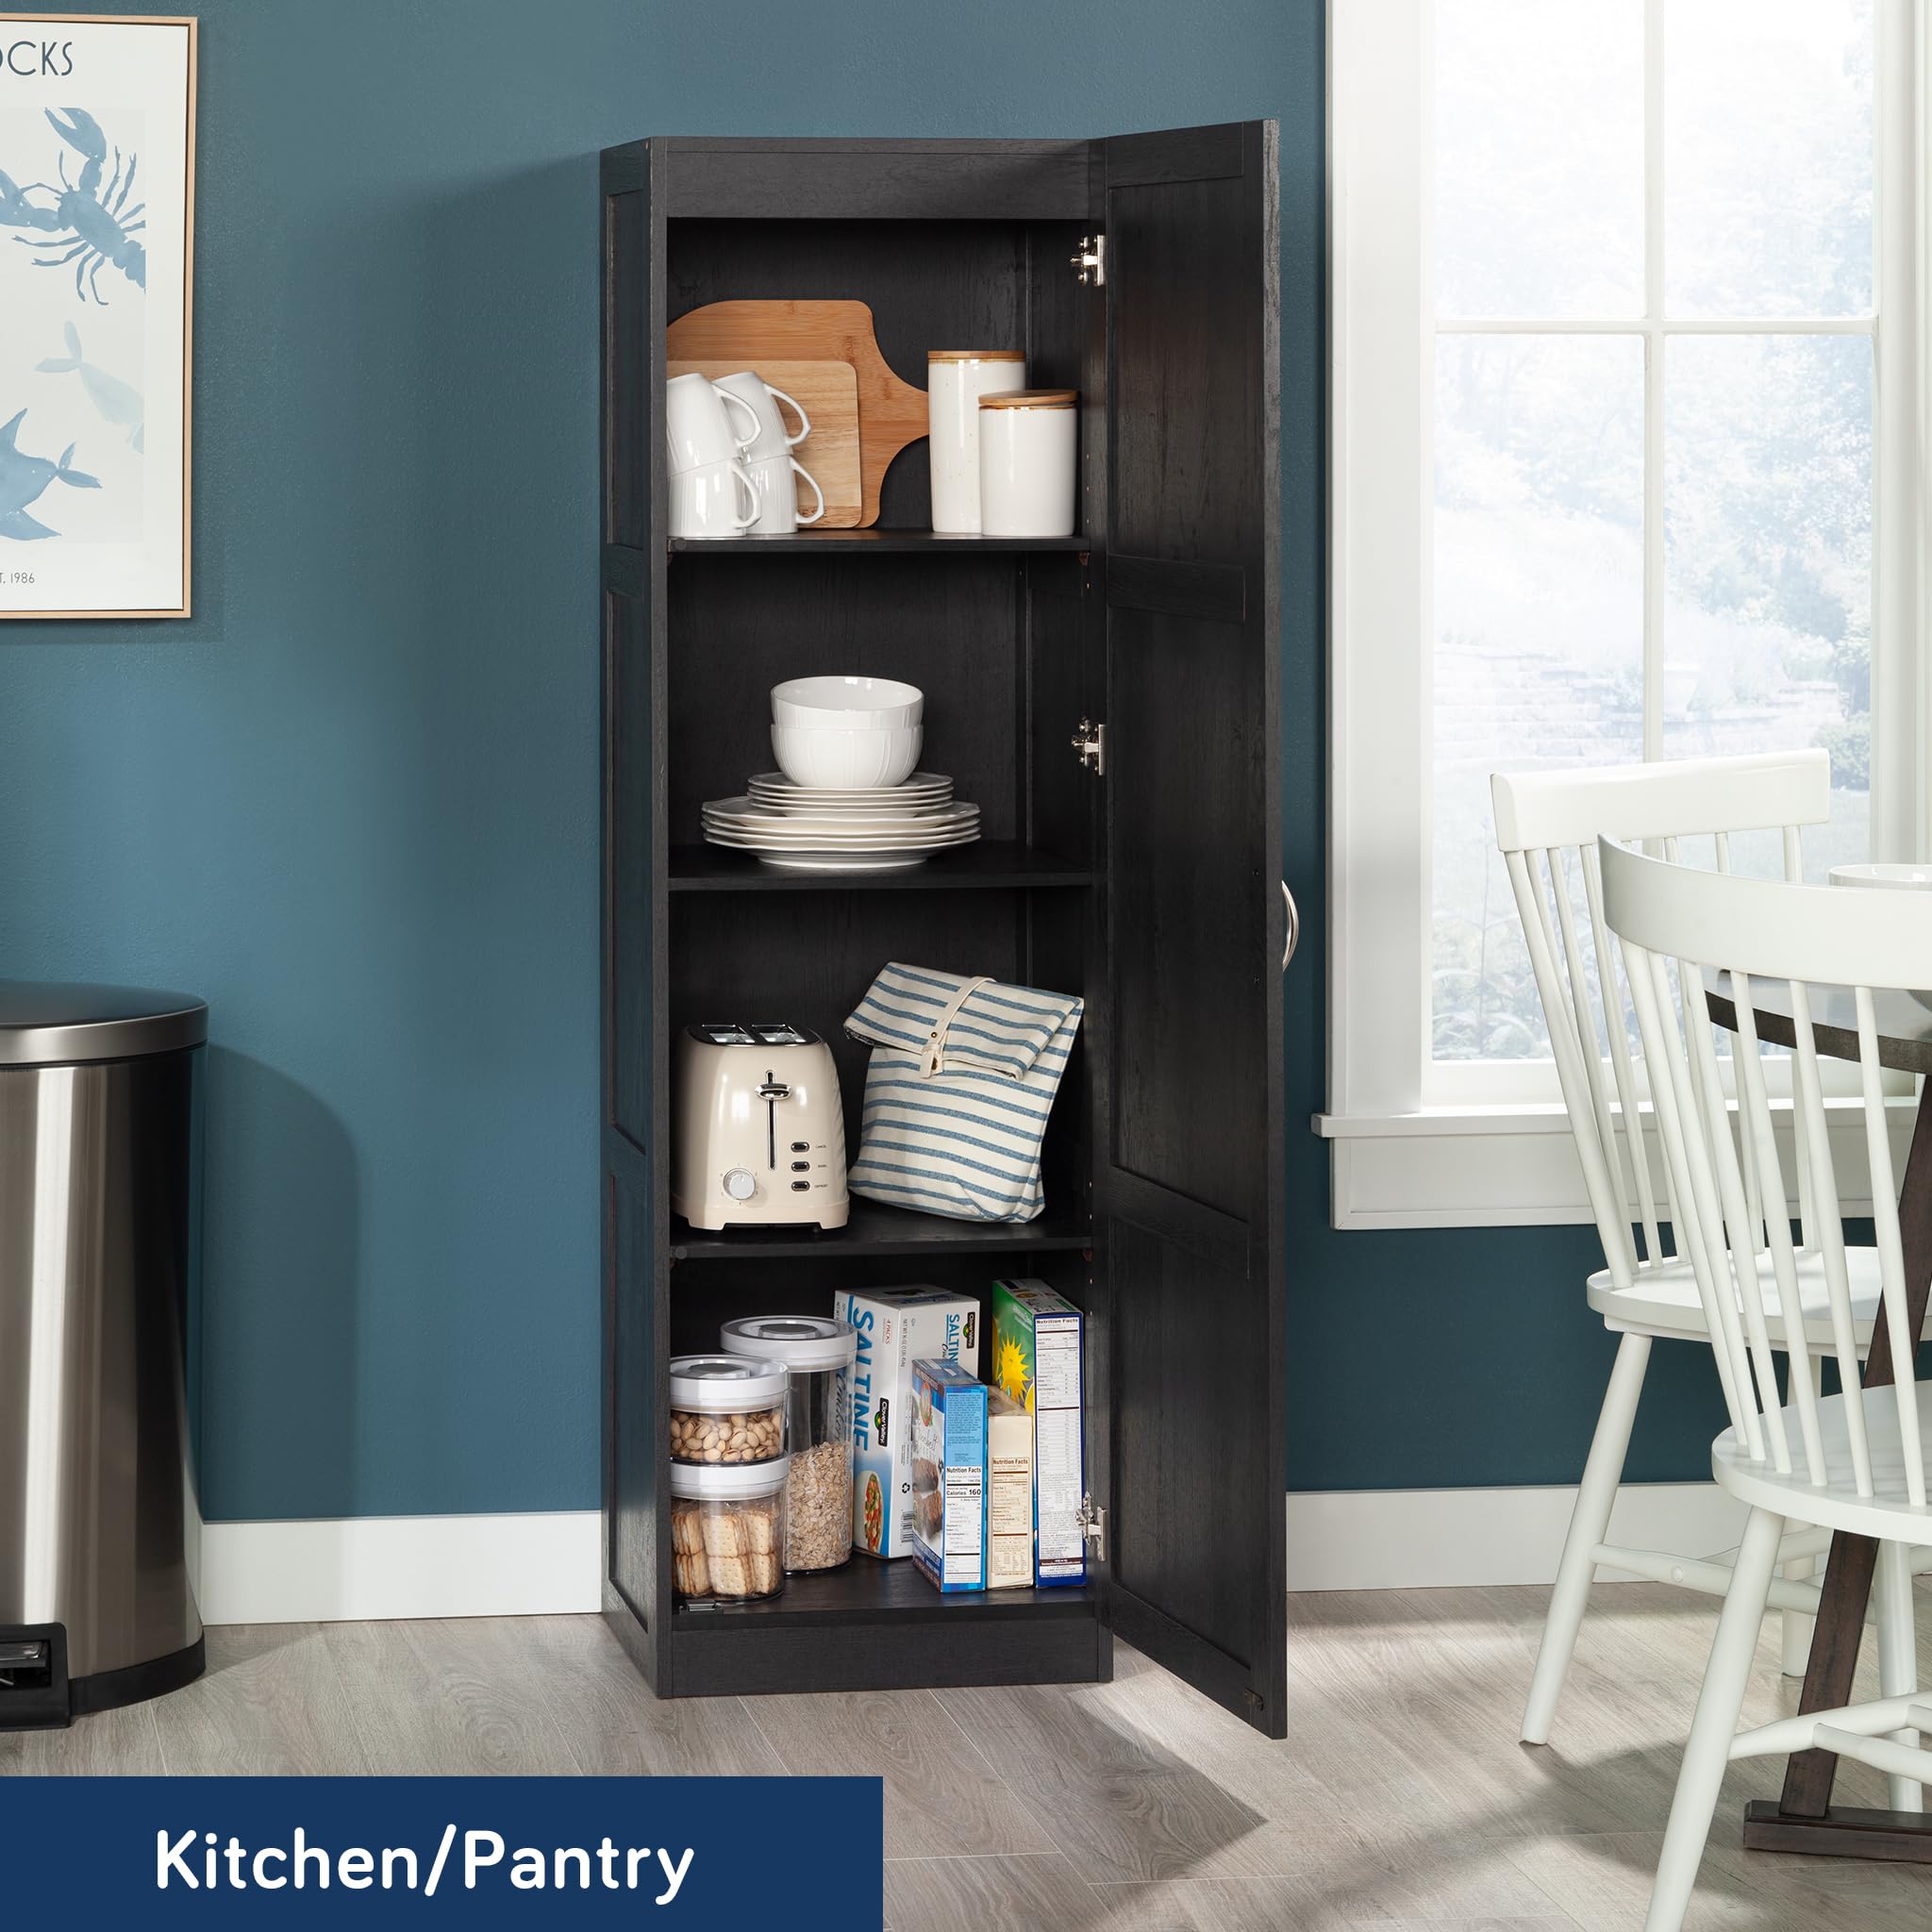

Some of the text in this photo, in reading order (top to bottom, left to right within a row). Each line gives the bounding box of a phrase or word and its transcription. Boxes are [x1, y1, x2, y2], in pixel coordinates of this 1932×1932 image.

[0, 41, 73, 75] CKS
[10, 572, 35, 584] 1986
[853, 1306, 874, 1451] SALTINE
